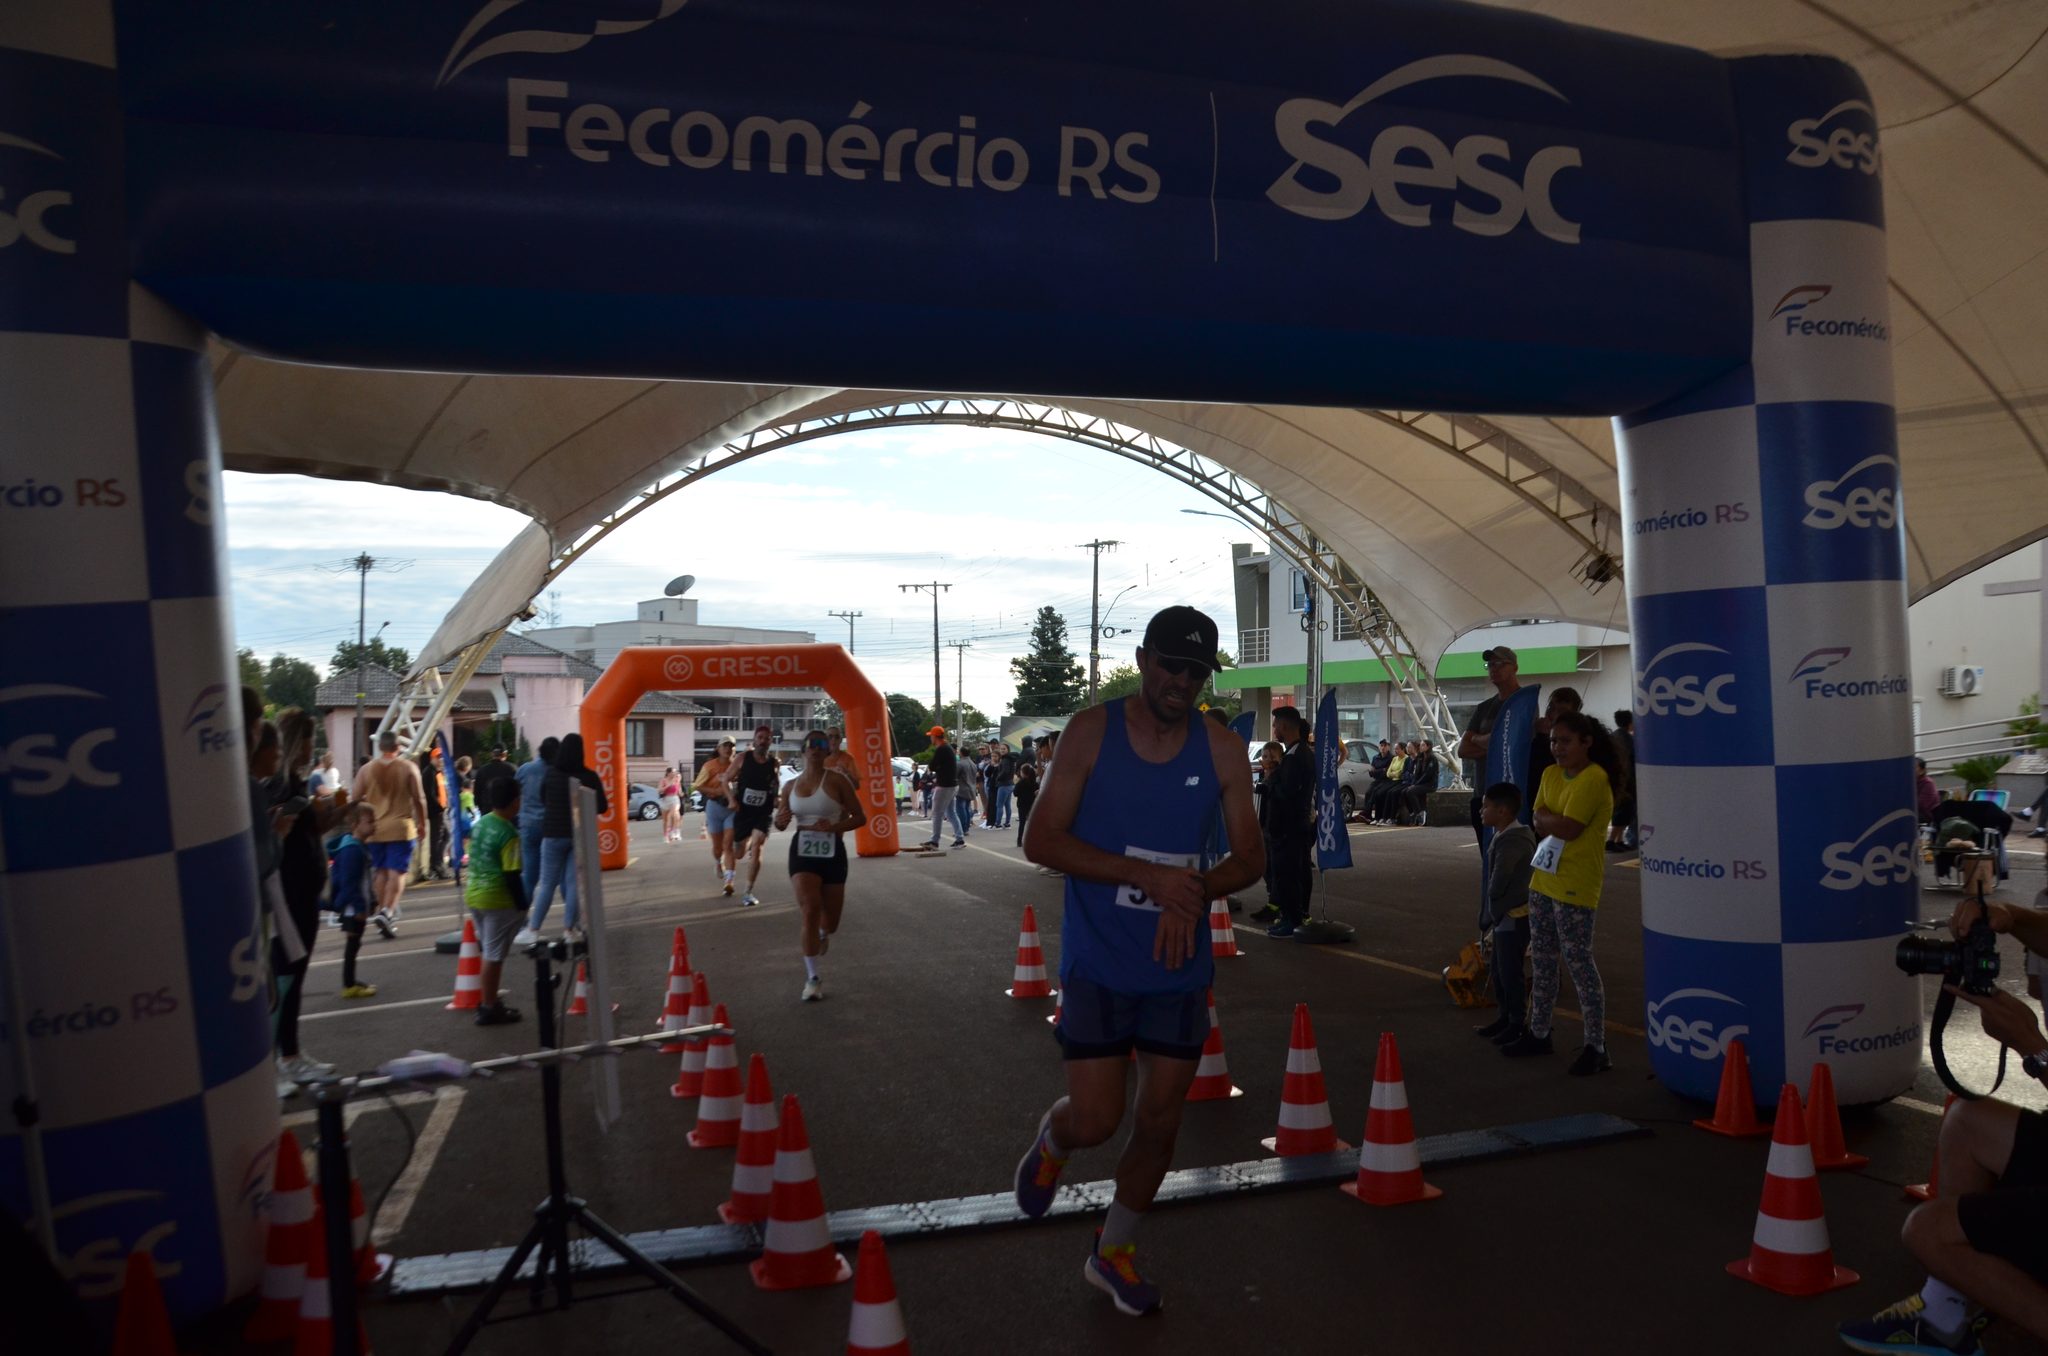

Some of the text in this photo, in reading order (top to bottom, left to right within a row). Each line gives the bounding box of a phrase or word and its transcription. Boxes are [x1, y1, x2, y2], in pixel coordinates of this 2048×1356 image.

[507, 77, 1161, 204] Fecomércio RS
[1785, 118, 1880, 176] Ses
[1265, 97, 1582, 244] Sesc
[1787, 315, 1887, 341] Fecomérci
[75, 478, 126, 507] RS
[1802, 479, 1899, 530] Ses
[1715, 502, 1749, 523] RS
[702, 654, 808, 678] CRESOL
[0, 727, 121, 796] sc
[864, 720, 887, 808] CRESOL
[1319, 788, 1336, 852] Sesc
[803, 841, 830, 855] 219
[1533, 848, 1554, 869] 93
[1733, 860, 1767, 880] RS
[131, 986, 178, 1021] RS
